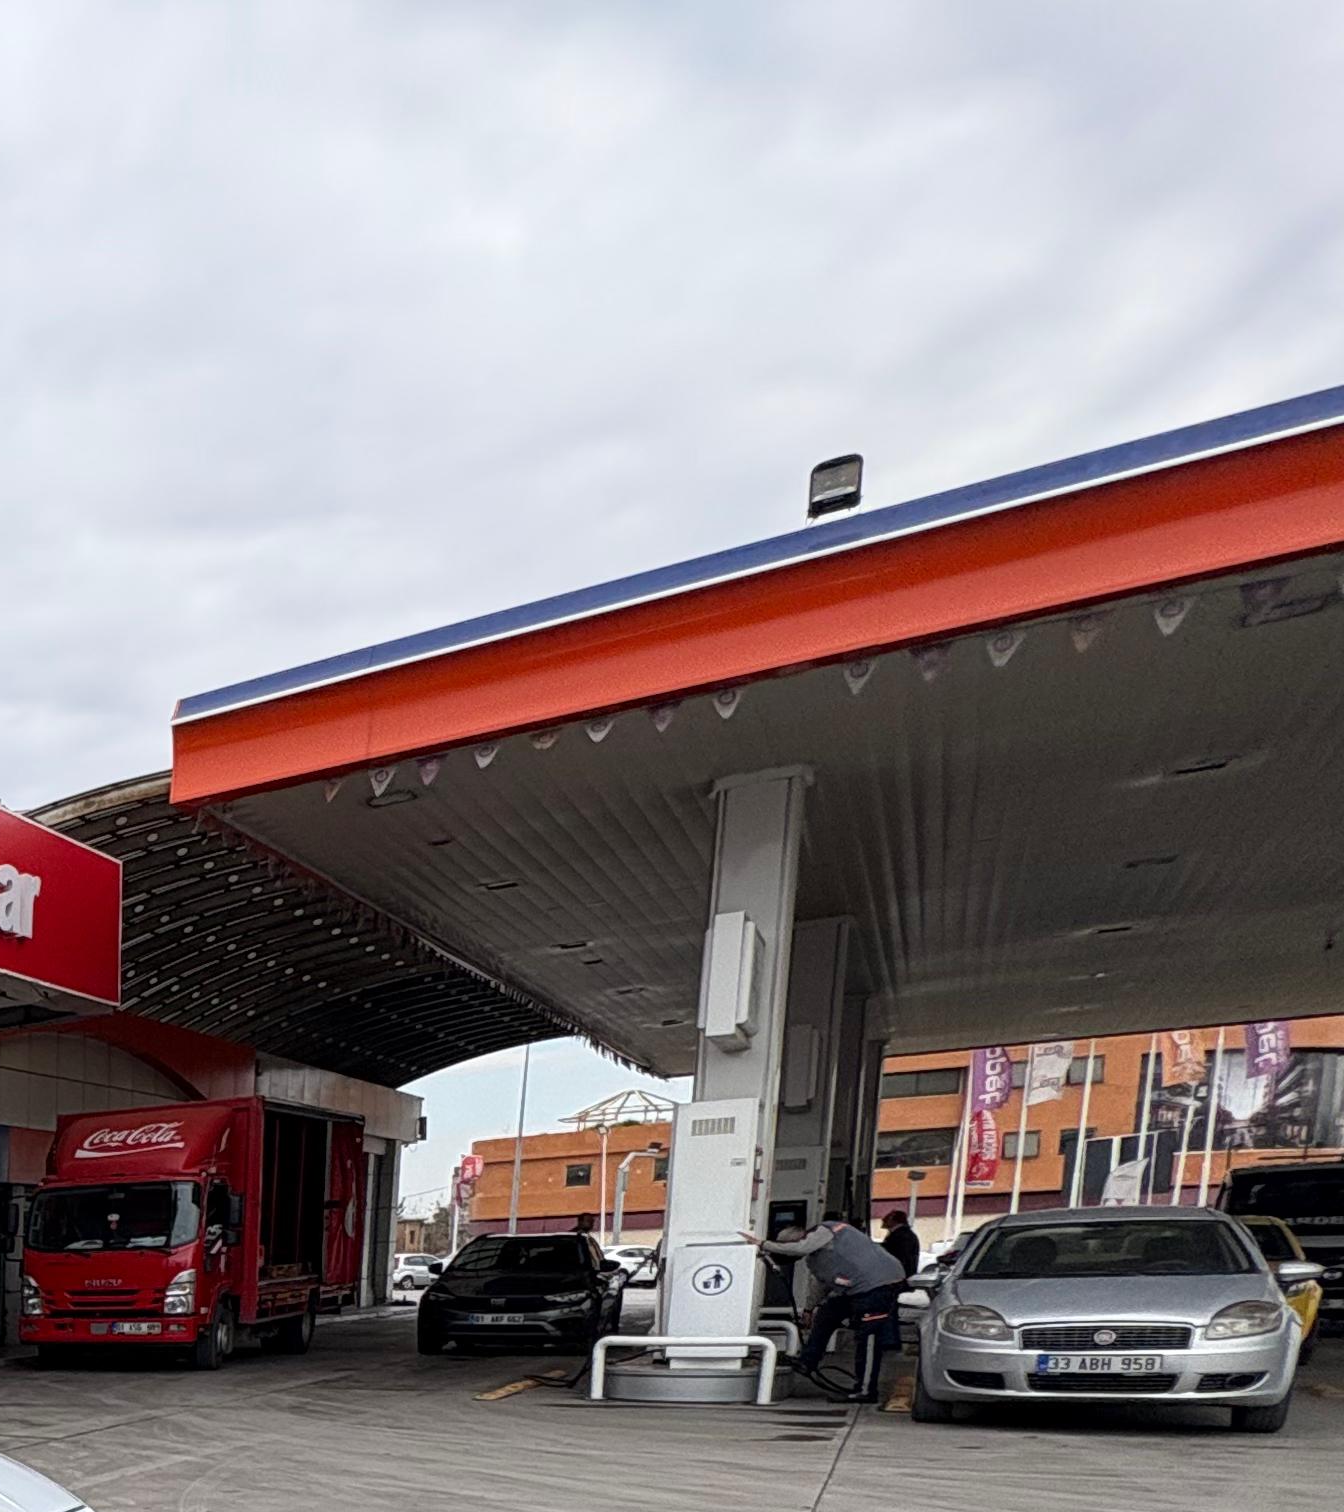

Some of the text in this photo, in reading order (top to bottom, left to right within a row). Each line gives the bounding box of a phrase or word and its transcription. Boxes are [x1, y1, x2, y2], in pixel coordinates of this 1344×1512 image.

[1049, 1357, 1155, 1370] 33 ABH 958
